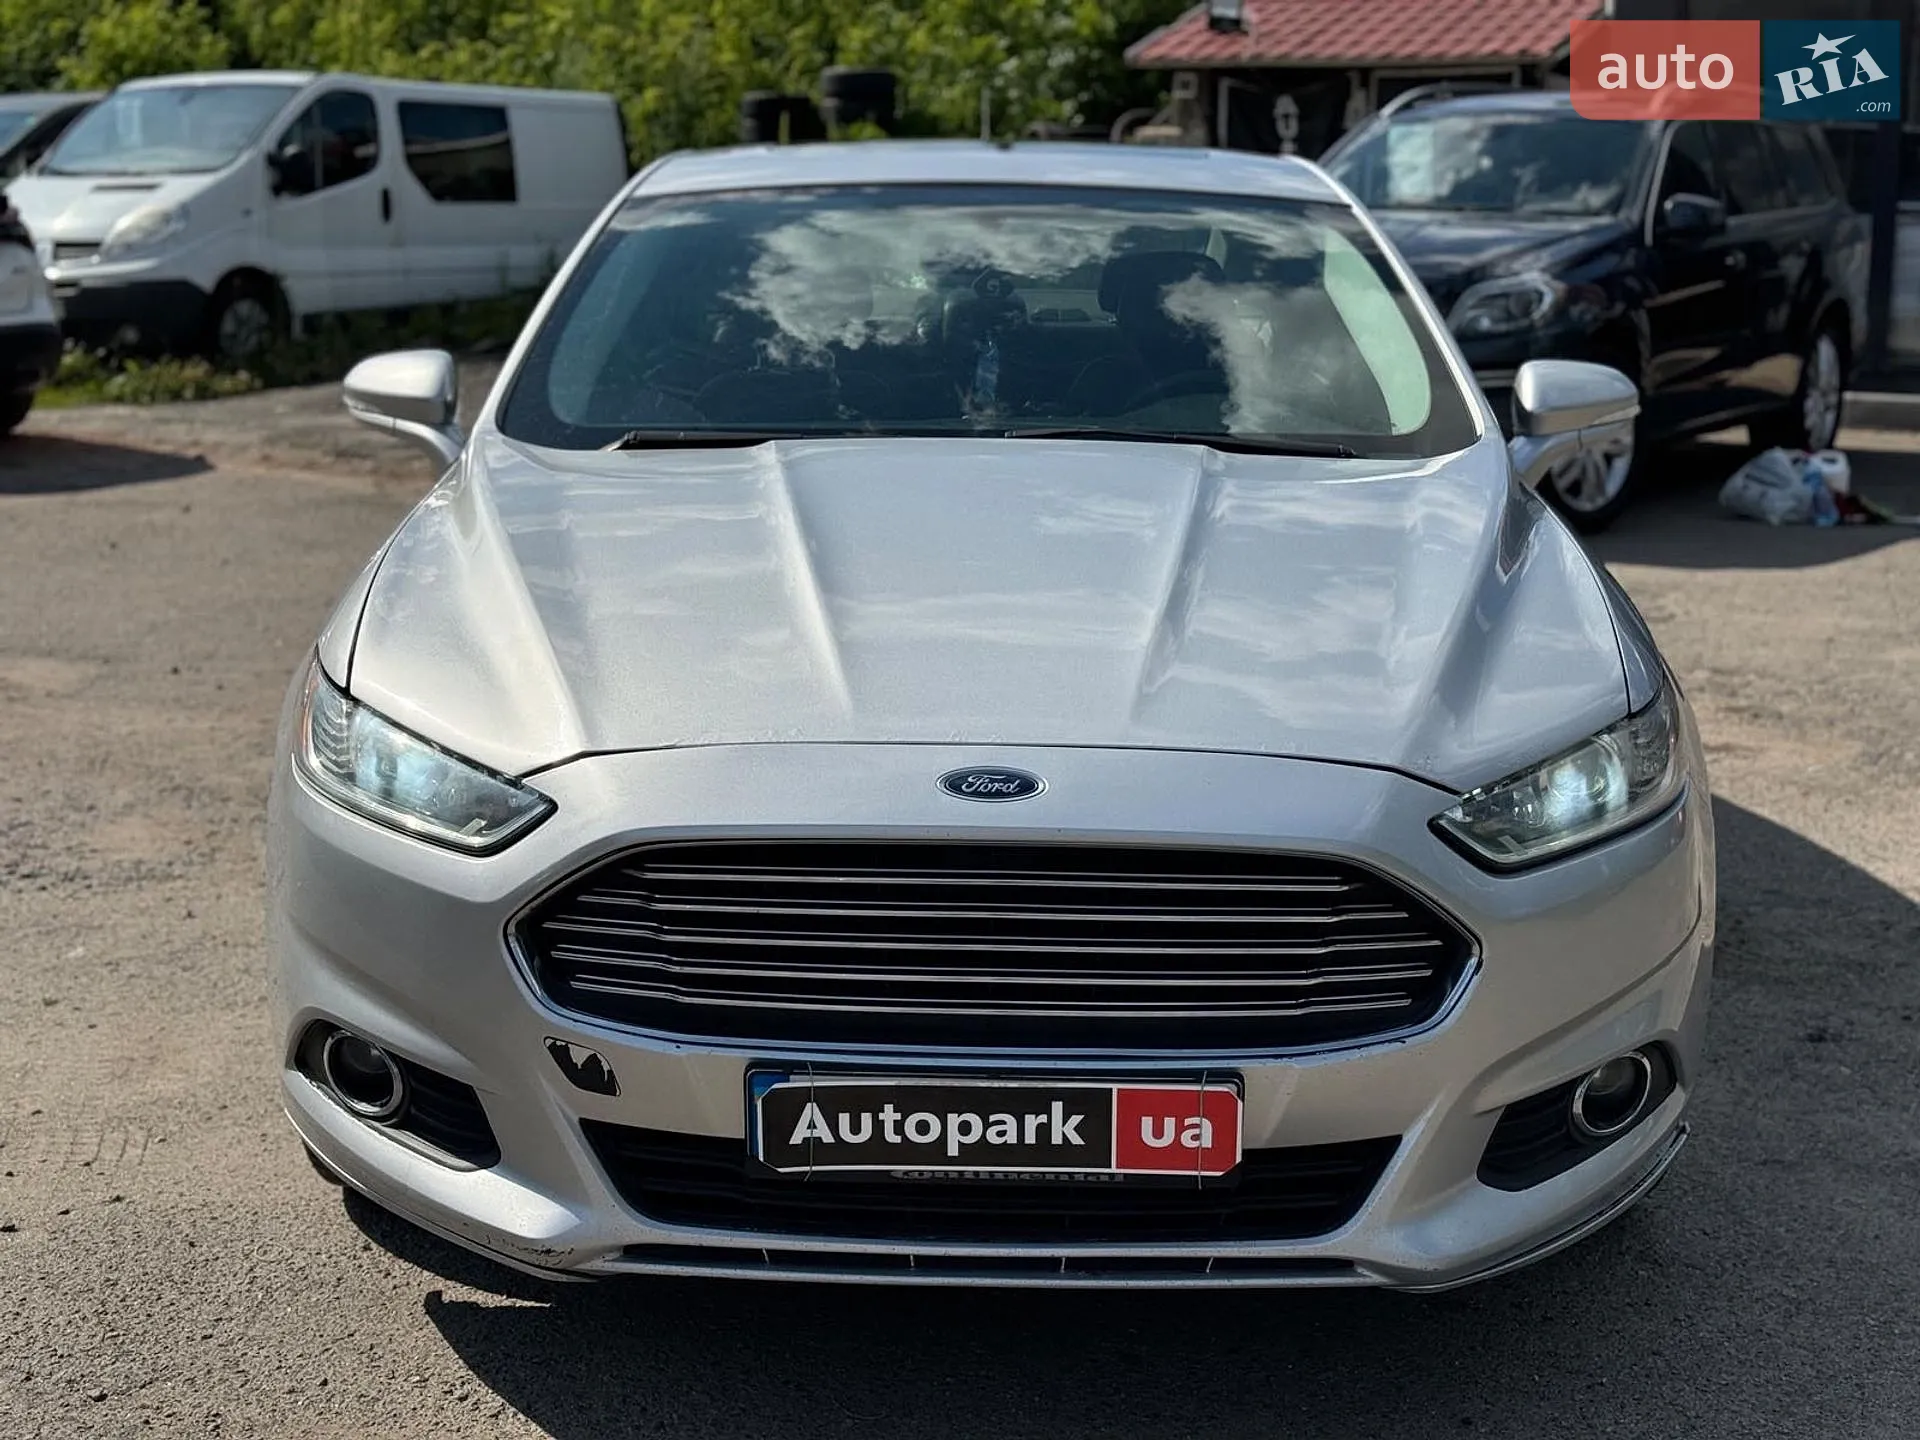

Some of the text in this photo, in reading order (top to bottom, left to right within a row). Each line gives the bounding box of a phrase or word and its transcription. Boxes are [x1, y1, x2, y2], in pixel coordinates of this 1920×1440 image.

[961, 773, 1020, 793] Ford
[788, 1101, 1214, 1156] Autopark ua
